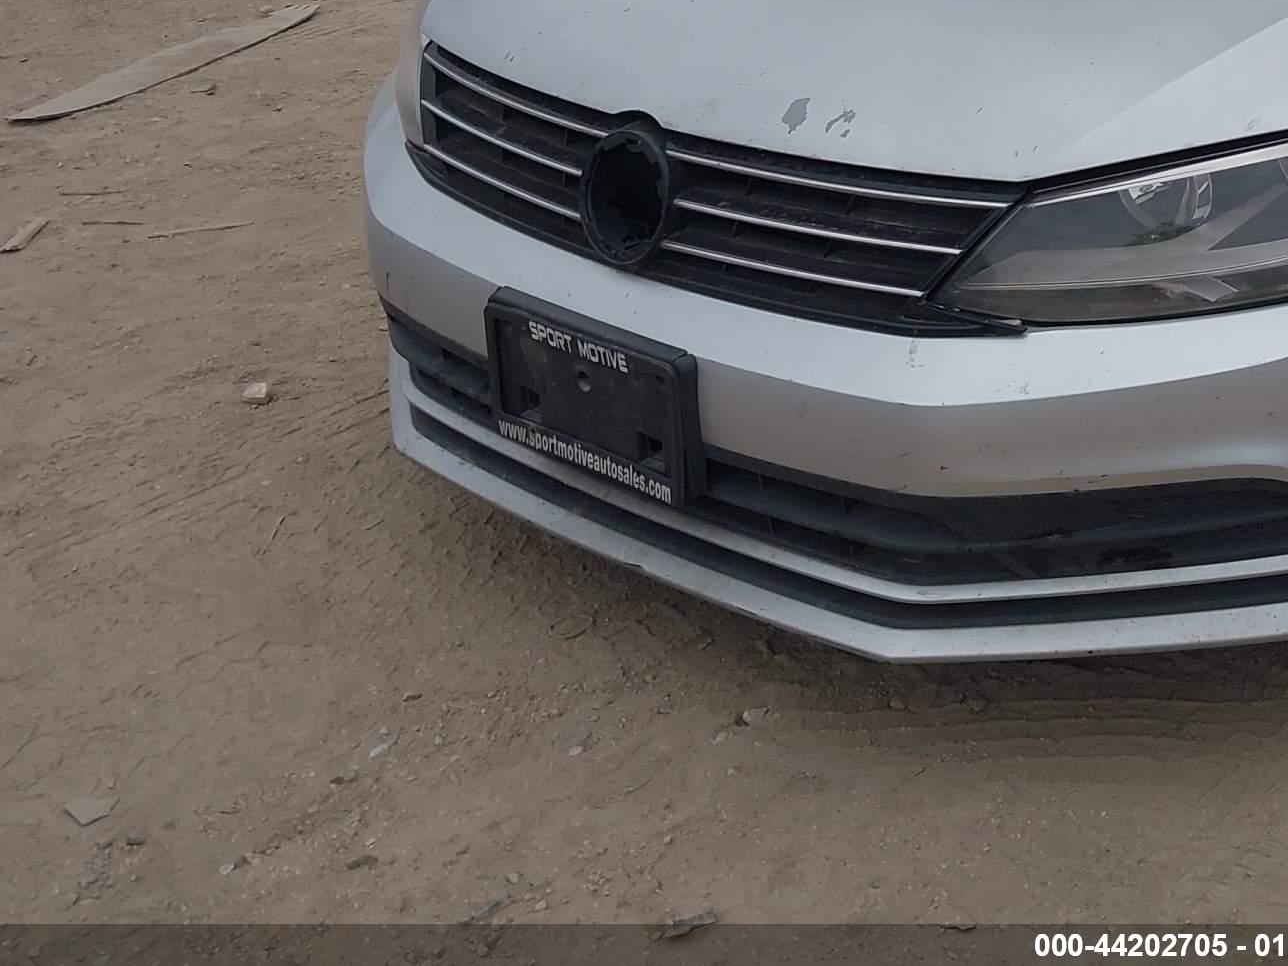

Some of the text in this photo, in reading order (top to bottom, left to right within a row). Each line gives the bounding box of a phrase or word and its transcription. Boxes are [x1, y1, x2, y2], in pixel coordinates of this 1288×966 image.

[528, 321, 629, 374] SPORT MOTIVE
[498, 419, 672, 505] www.sportmotiveautosales.com
